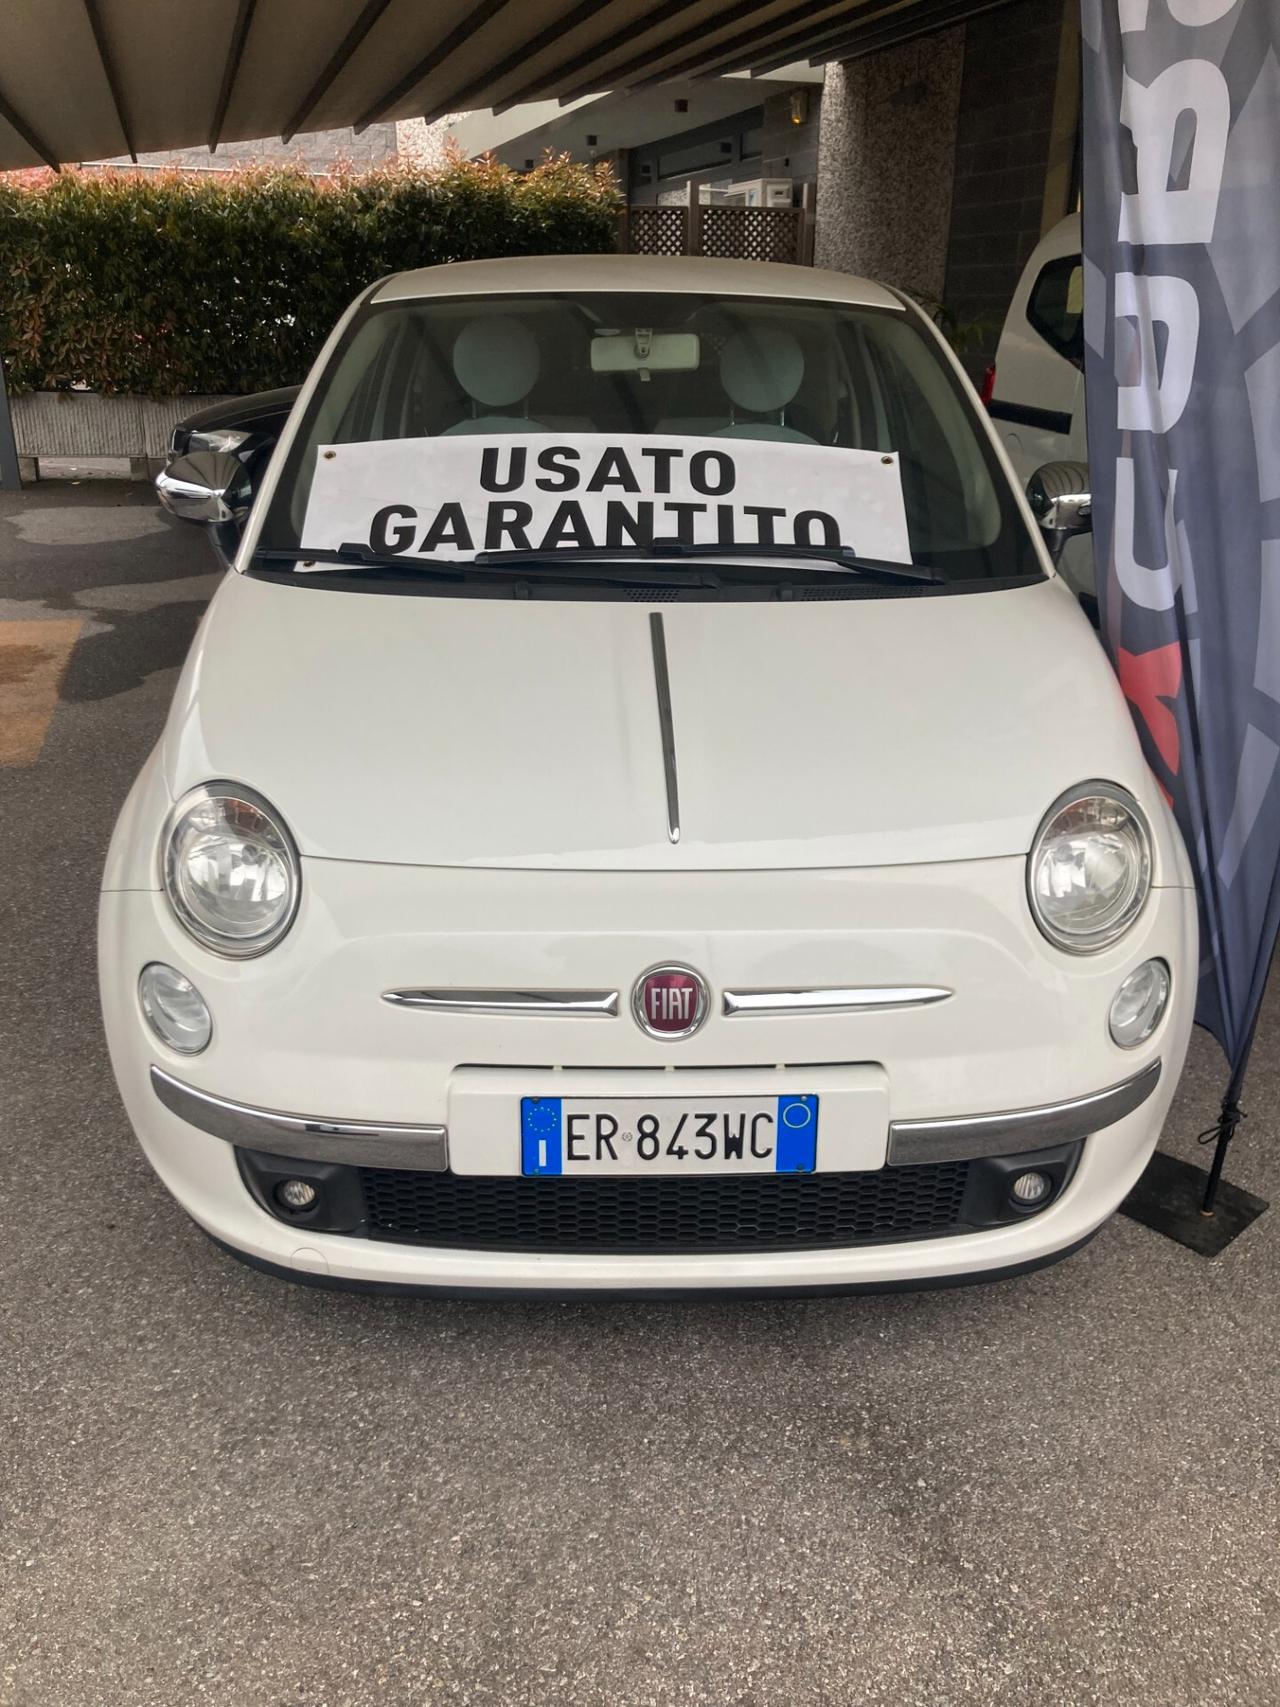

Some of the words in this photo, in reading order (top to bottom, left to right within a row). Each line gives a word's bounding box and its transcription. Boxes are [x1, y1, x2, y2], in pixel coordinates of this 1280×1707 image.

[479, 446, 736, 496] USATO
[369, 500, 842, 554] GARANTITO
[651, 987, 693, 1020] FIAT
[566, 1113, 618, 1161] ER
[637, 1112, 774, 1160] 843WC
